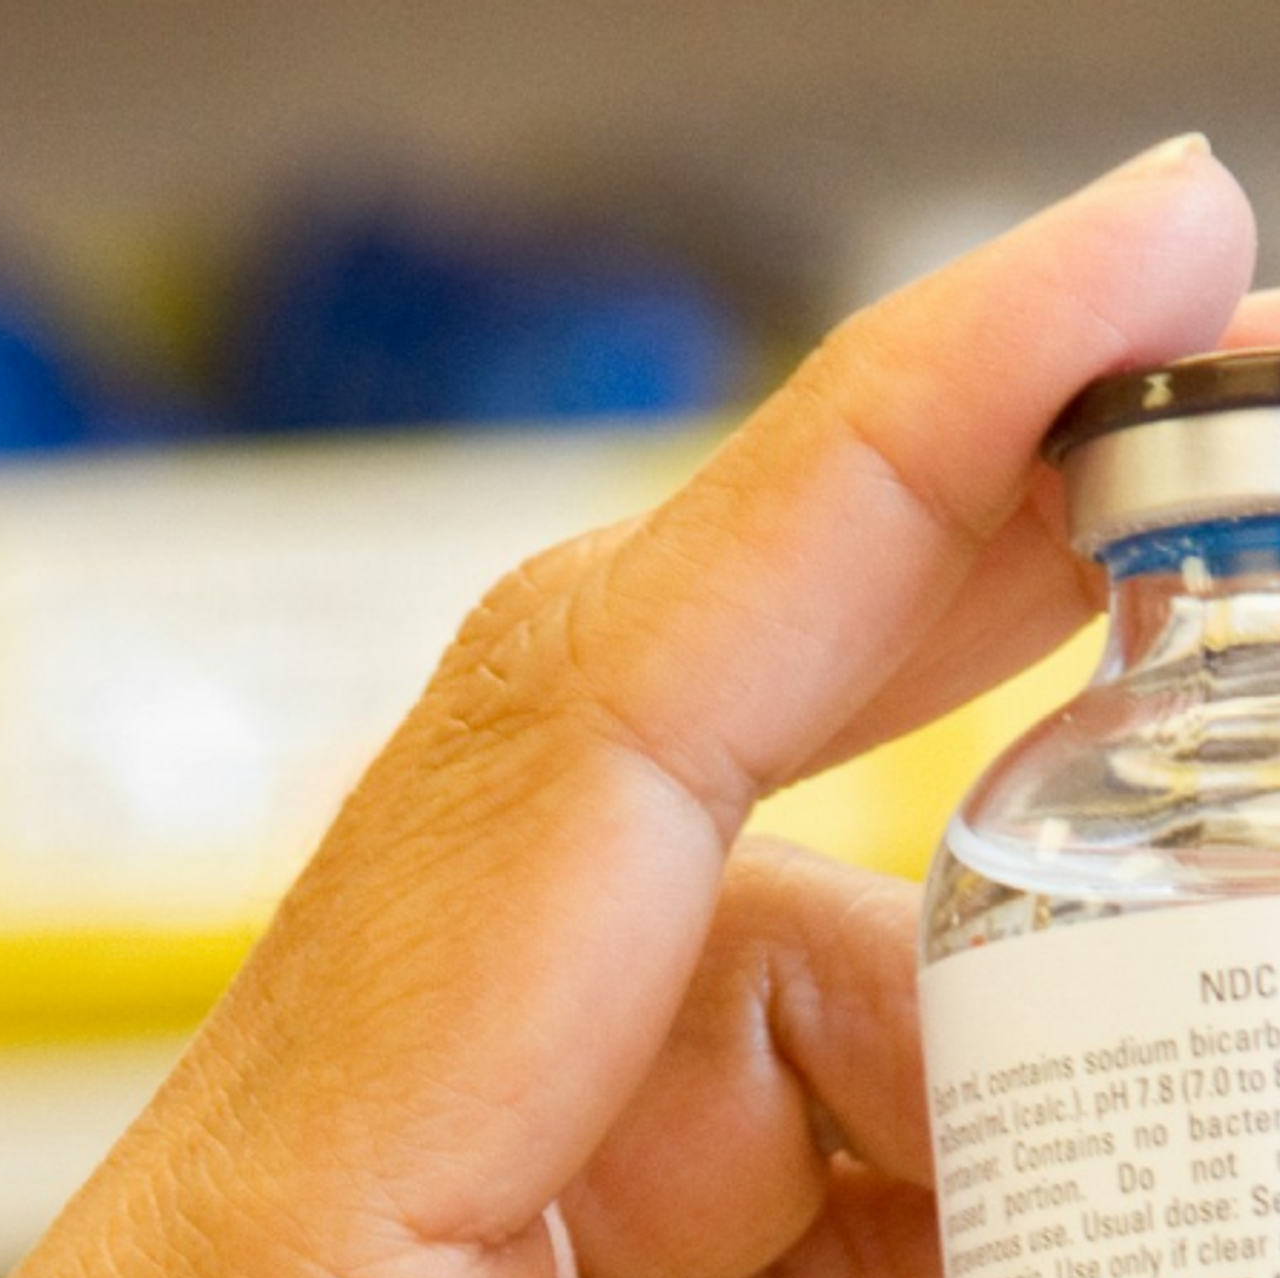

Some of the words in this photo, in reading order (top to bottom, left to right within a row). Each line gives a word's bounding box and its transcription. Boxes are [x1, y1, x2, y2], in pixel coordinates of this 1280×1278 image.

[1199, 963, 1276, 1005] NDC
[988, 1052, 1074, 1097] contains
[1083, 1035, 1179, 1076] sodium
[1094, 1080, 1129, 1121] pH
[1134, 1074, 1175, 1107] 7.8
[1181, 1065, 1231, 1104] (7.0
[1237, 1067, 1266, 1095] to
[1013, 1129, 1116, 1174] Contains
[1133, 1123, 1168, 1151] no
[1003, 1177, 1088, 1226] portion.
[1118, 1162, 1155, 1196] Do
[1191, 1153, 1238, 1185] not
[1029, 1222, 1073, 1254] use.
[1082, 1204, 1155, 1243] Usual
[1164, 1198, 1239, 1230] dose:
[1171, 1237, 1189, 1269] if
[1197, 1233, 1268, 1266] clear
